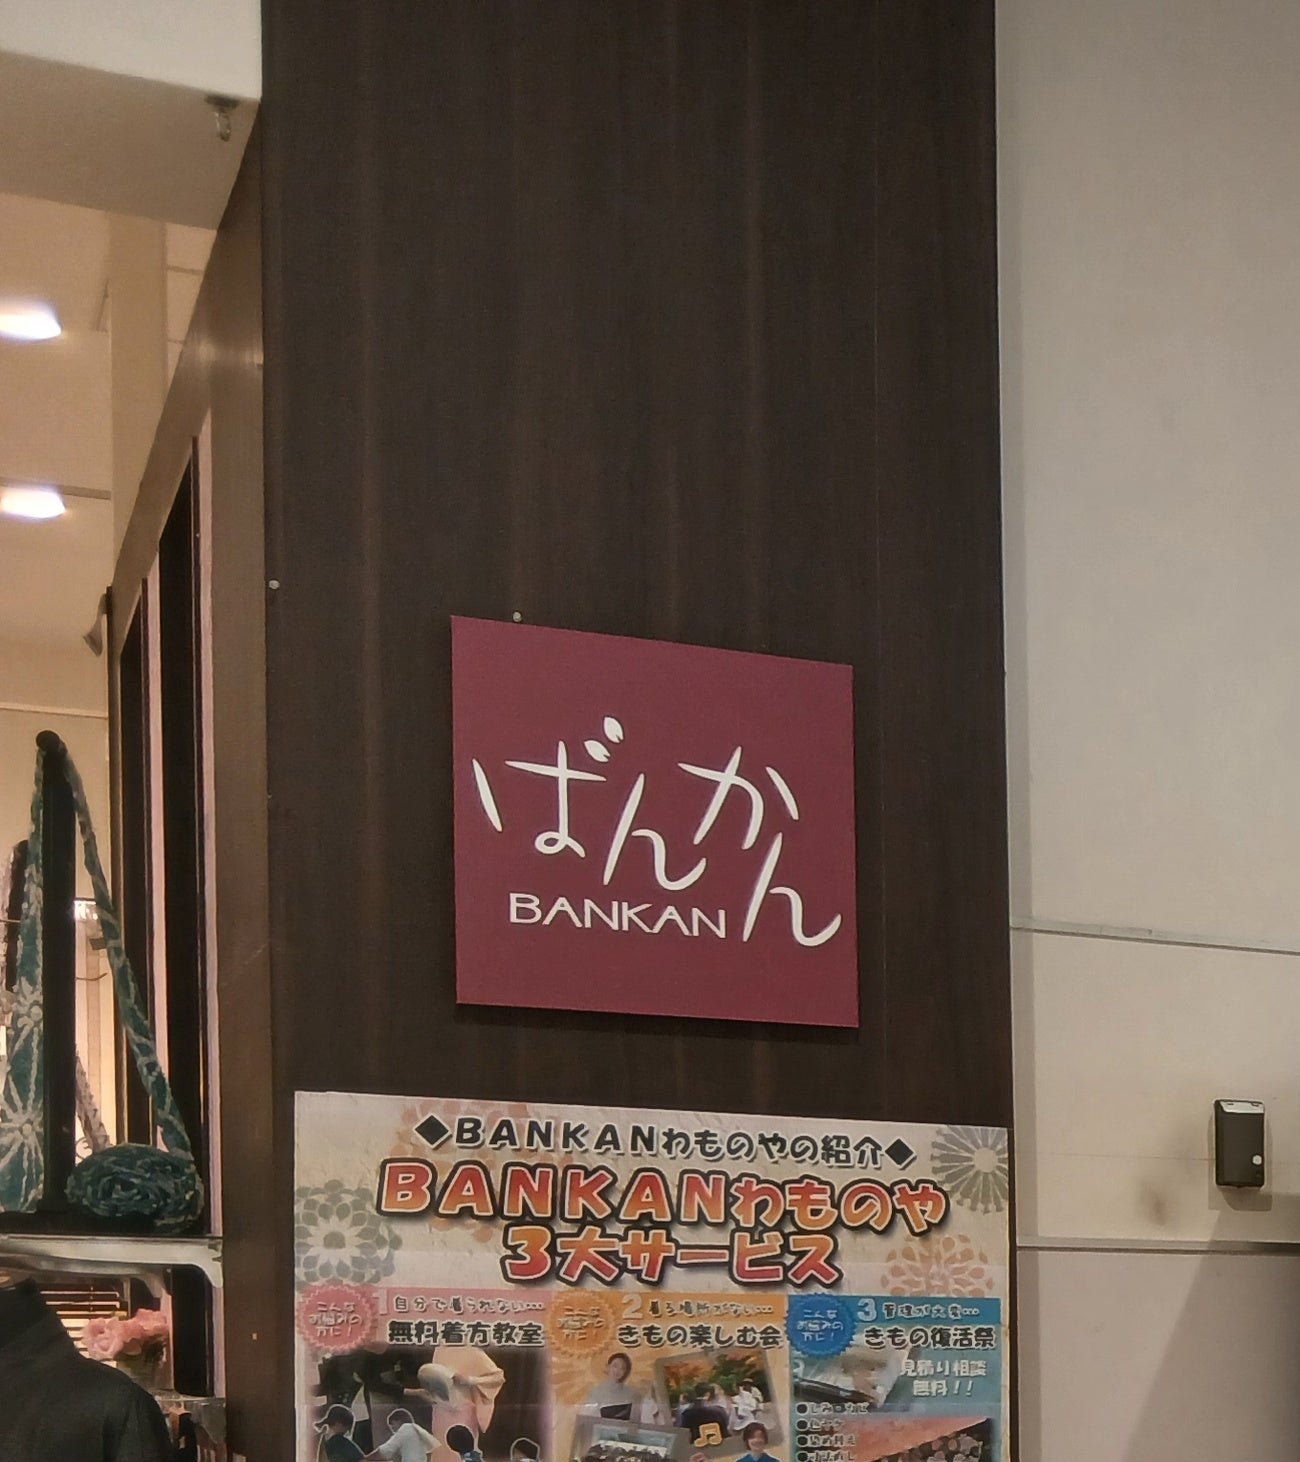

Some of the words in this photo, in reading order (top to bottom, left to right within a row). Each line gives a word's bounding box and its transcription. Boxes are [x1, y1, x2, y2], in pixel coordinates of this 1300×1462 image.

[472, 716, 842, 947] ばんかん
[509, 892, 726, 939] BANKAN
[377, 1157, 948, 1235] BANKANわものや
[499, 1224, 844, 1288] 3大サービス
[622, 1293, 644, 1320] 2
[857, 1298, 877, 1322] 3
[388, 1320, 545, 1346] 無料着方教室
[618, 1325, 783, 1347] きもの楽しむ会
[864, 1327, 996, 1349] きもの復活祭
